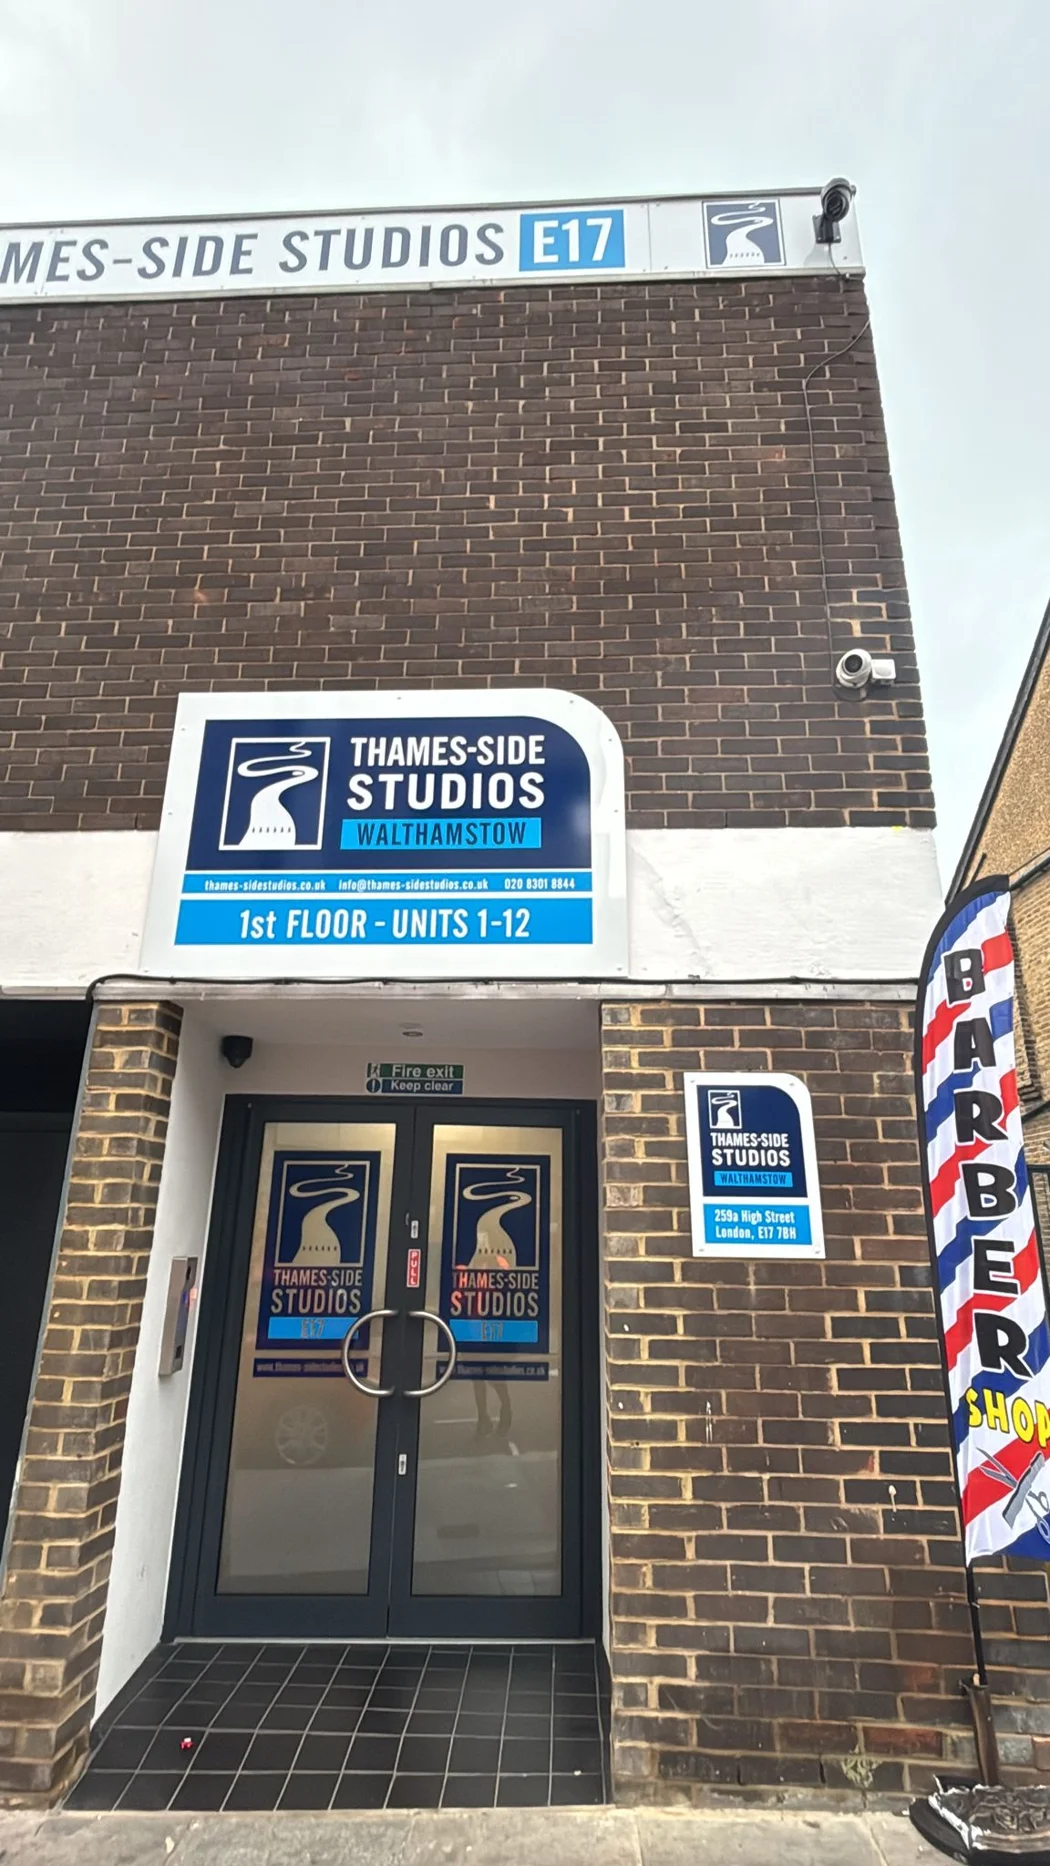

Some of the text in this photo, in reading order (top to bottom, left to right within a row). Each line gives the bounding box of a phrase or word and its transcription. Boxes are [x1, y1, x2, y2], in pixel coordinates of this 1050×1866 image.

[279, 222, 505, 273] STUDIOS
[533, 217, 613, 264] E17
[350, 735, 545, 767] THAMES-SIDE
[347, 772, 545, 811] STUDIOS
[357, 821, 526, 846] WALTHAMSTOW
[204, 878, 575, 893] thames-sidestudios.co.uk info@thames-sidestudios.co.uk 020 8301 8844
[240, 907, 531, 939] 1st FLOOR - UNITS 1-12
[391, 1064, 454, 1078] Fire exit
[390, 1080, 454, 1093] Keep clear
[710, 1132, 789, 1148] THAMES-SIDE
[712, 1149, 791, 1167] STUDIOS
[944, 948, 1034, 1379] BARBER
[720, 1173, 787, 1185] WALTHAMSTOW
[715, 1209, 795, 1225] 259a High Street
[715, 1225, 796, 1240] London, E17 7BH
[410, 1251, 418, 1285] PULL
[273, 1269, 362, 1287] THAMES-SIDE
[452, 1272, 539, 1290] THAMES-SIDE
[270, 1288, 361, 1314] STUDIOS
[450, 1291, 539, 1317] STUDIOS
